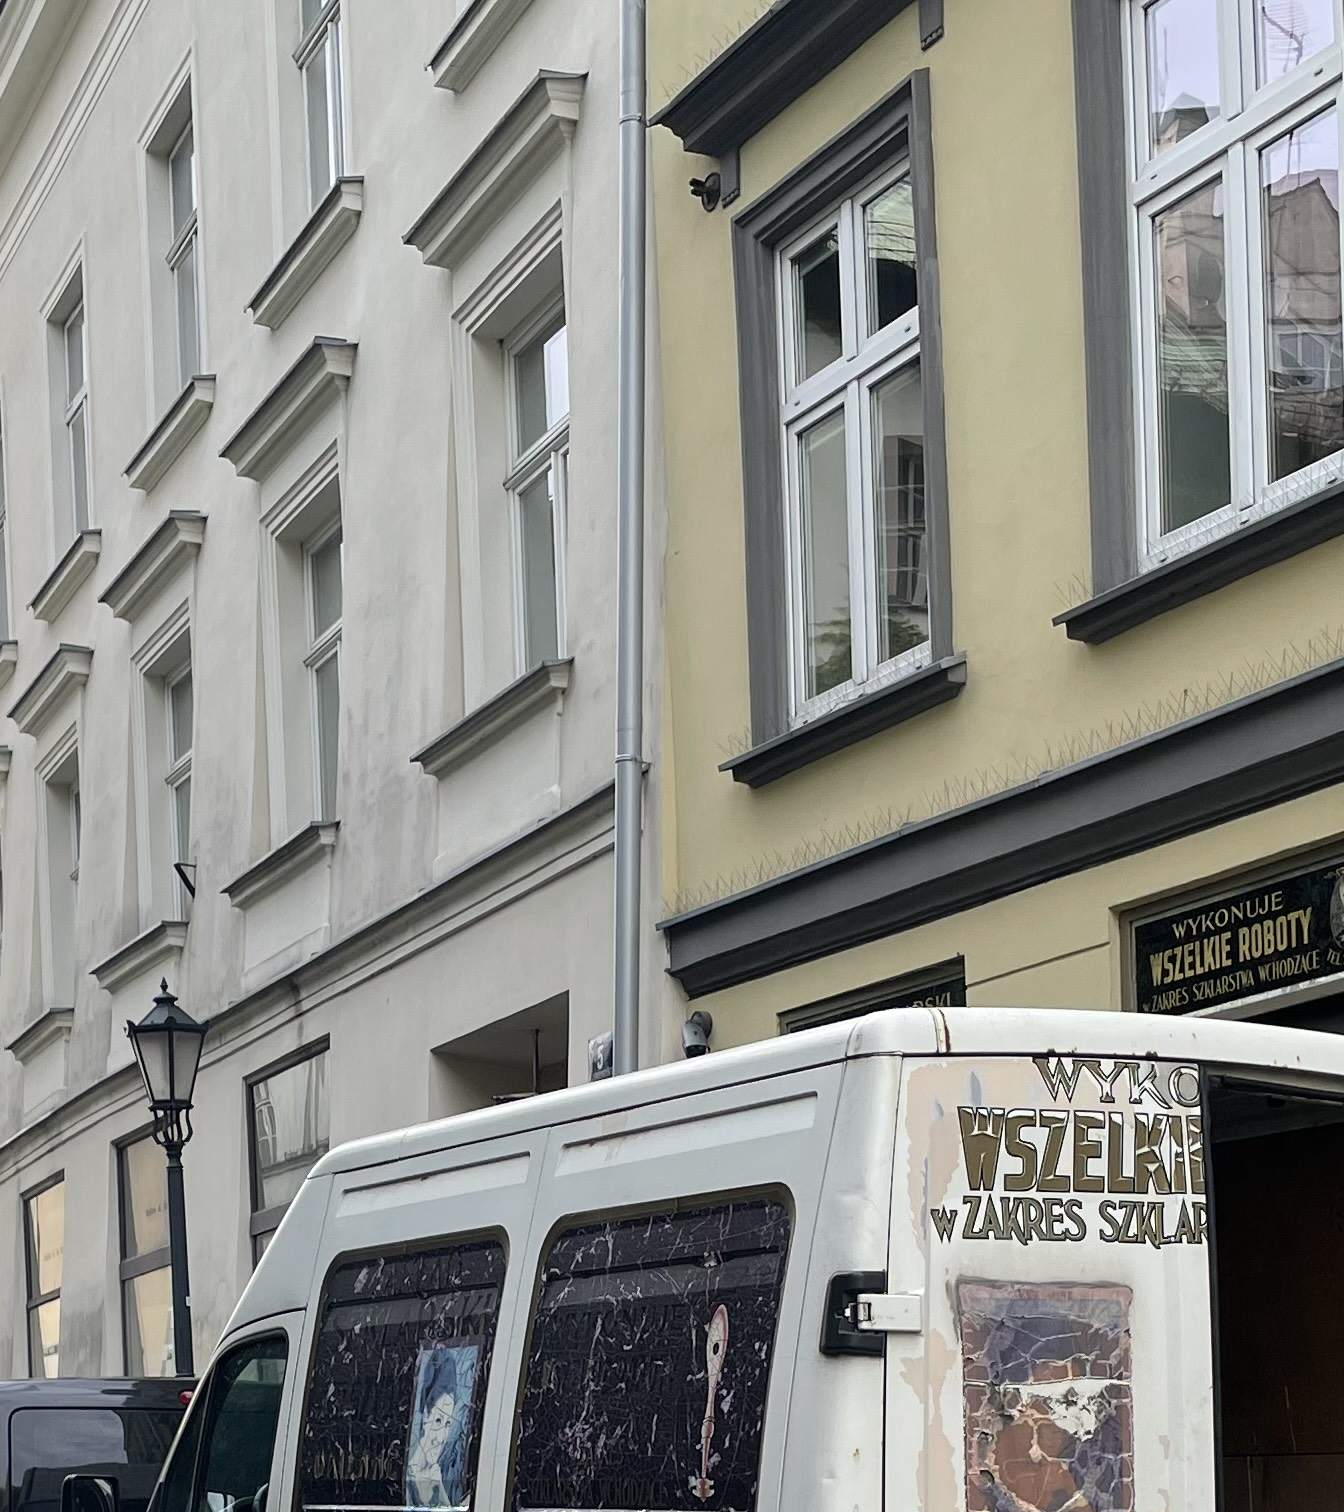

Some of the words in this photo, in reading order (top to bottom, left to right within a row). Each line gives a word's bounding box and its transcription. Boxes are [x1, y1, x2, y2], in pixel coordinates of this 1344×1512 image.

[1172, 891, 1285, 940] WYKONUJE
[1149, 931, 1233, 987] WSZELKIE
[1238, 906, 1313, 963] ROBOTY
[1151, 985, 1189, 1013] ZAKRES
[1192, 969, 1255, 1001] SZKLARSTWA
[962, 1194, 1087, 1246] ZAKRES
